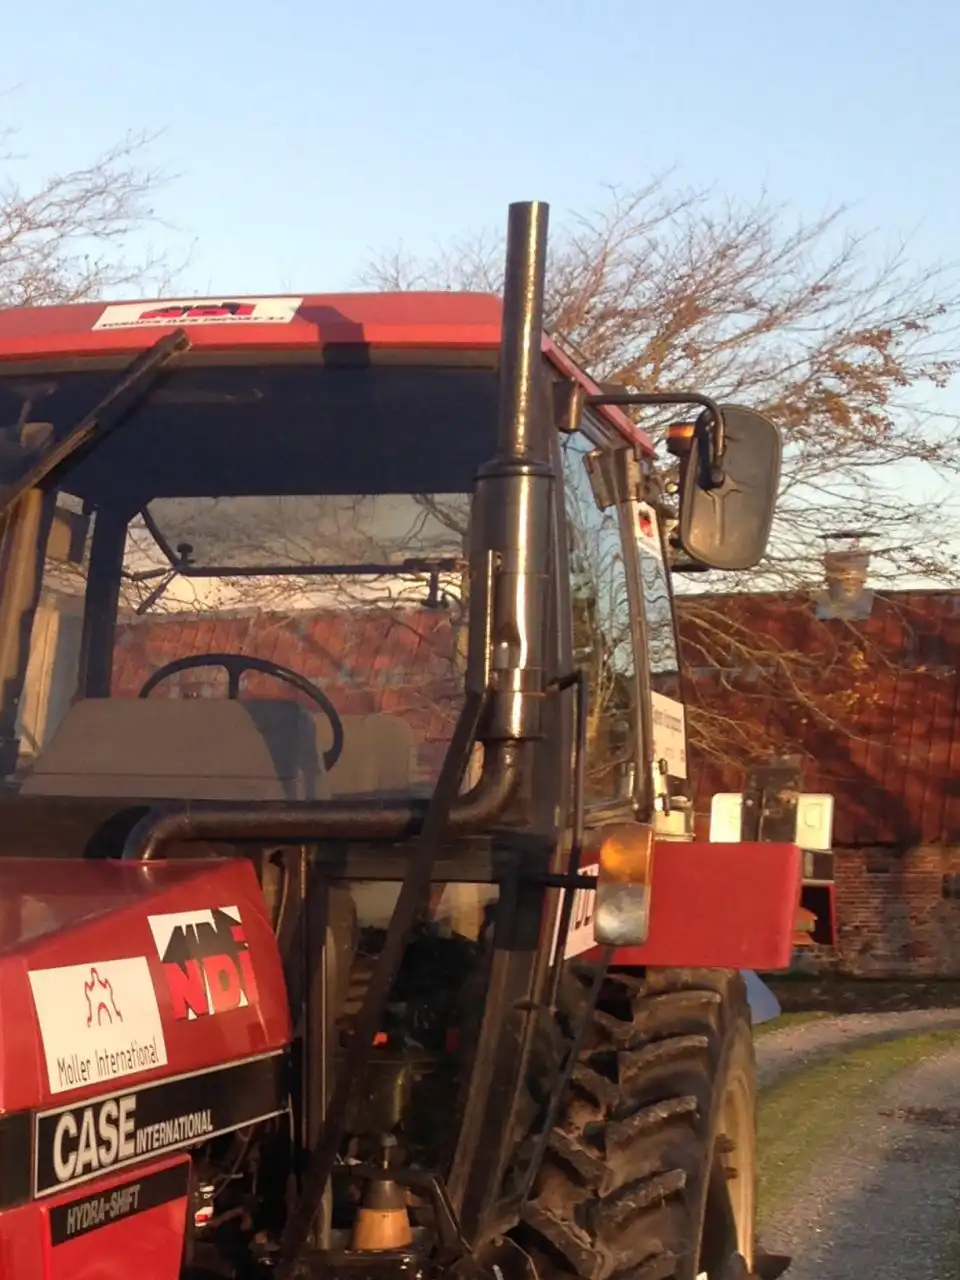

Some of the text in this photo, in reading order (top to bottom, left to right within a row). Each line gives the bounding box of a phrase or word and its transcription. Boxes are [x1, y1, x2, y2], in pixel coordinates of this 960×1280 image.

[56, 1036, 159, 1088] Moller International
[53, 1094, 214, 1182] CASE INTERNATIONAL
[66, 1184, 141, 1235] HYDRA-SHIFT
